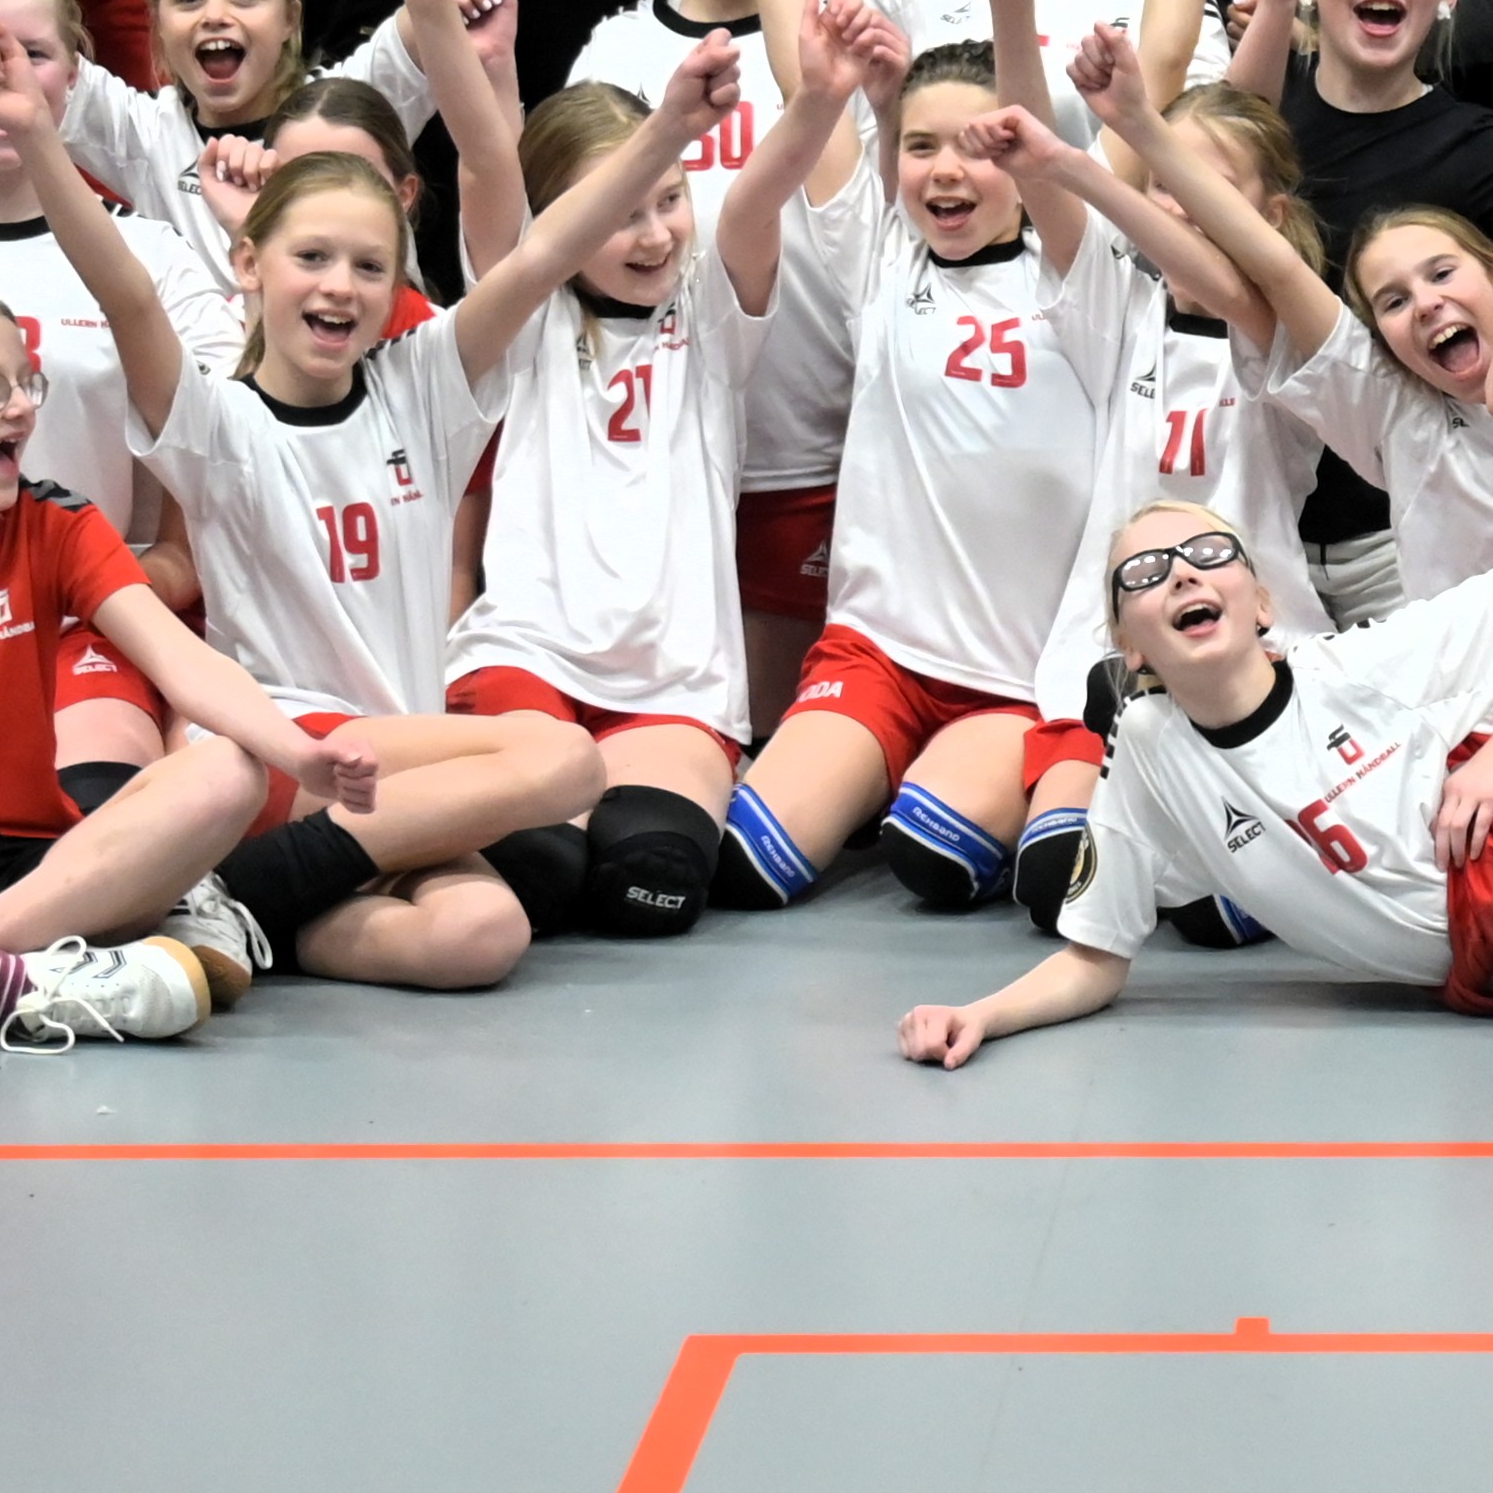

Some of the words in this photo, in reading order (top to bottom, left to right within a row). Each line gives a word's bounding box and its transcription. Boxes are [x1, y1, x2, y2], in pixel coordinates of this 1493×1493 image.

[178, 180, 202, 195] SELEC
[61, 318, 98, 328] ULLERN
[944, 315, 1028, 389] 25
[1159, 408, 1209, 476] 11
[316, 502, 381, 583] 19
[1324, 776, 1357, 804] ULLERN
[1356, 742, 1402, 780] HÅNDBALL
[1228, 821, 1266, 853] SELECT
[627, 886, 686, 909] SELECT
